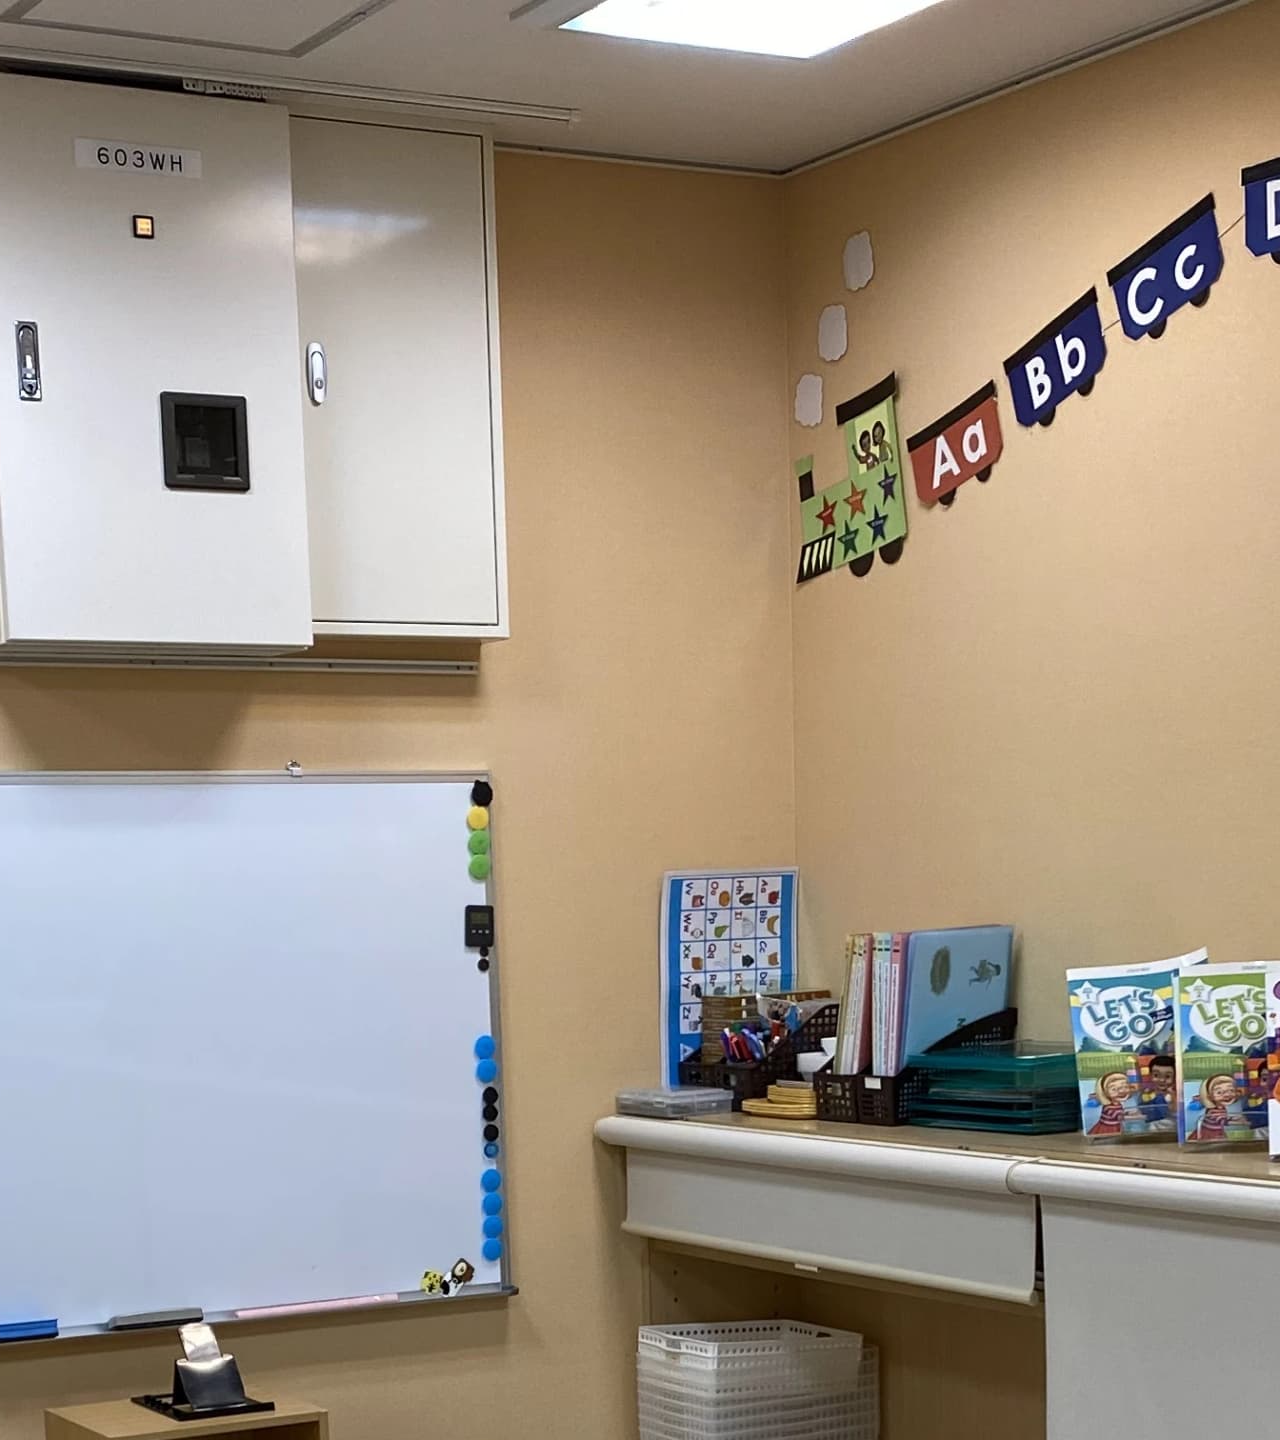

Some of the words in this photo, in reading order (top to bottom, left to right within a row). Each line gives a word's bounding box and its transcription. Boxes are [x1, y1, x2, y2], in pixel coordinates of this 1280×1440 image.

[96, 147, 184, 173] 603WH
[1126, 244, 1206, 327] Cc
[1024, 333, 1087, 410] Bb
[931, 416, 990, 491] Aa
[1085, 989, 1156, 1023] LET'S
[1195, 988, 1266, 1024] LET'S
[1104, 1014, 1154, 1042] GO
[1213, 1014, 1267, 1042] GO
